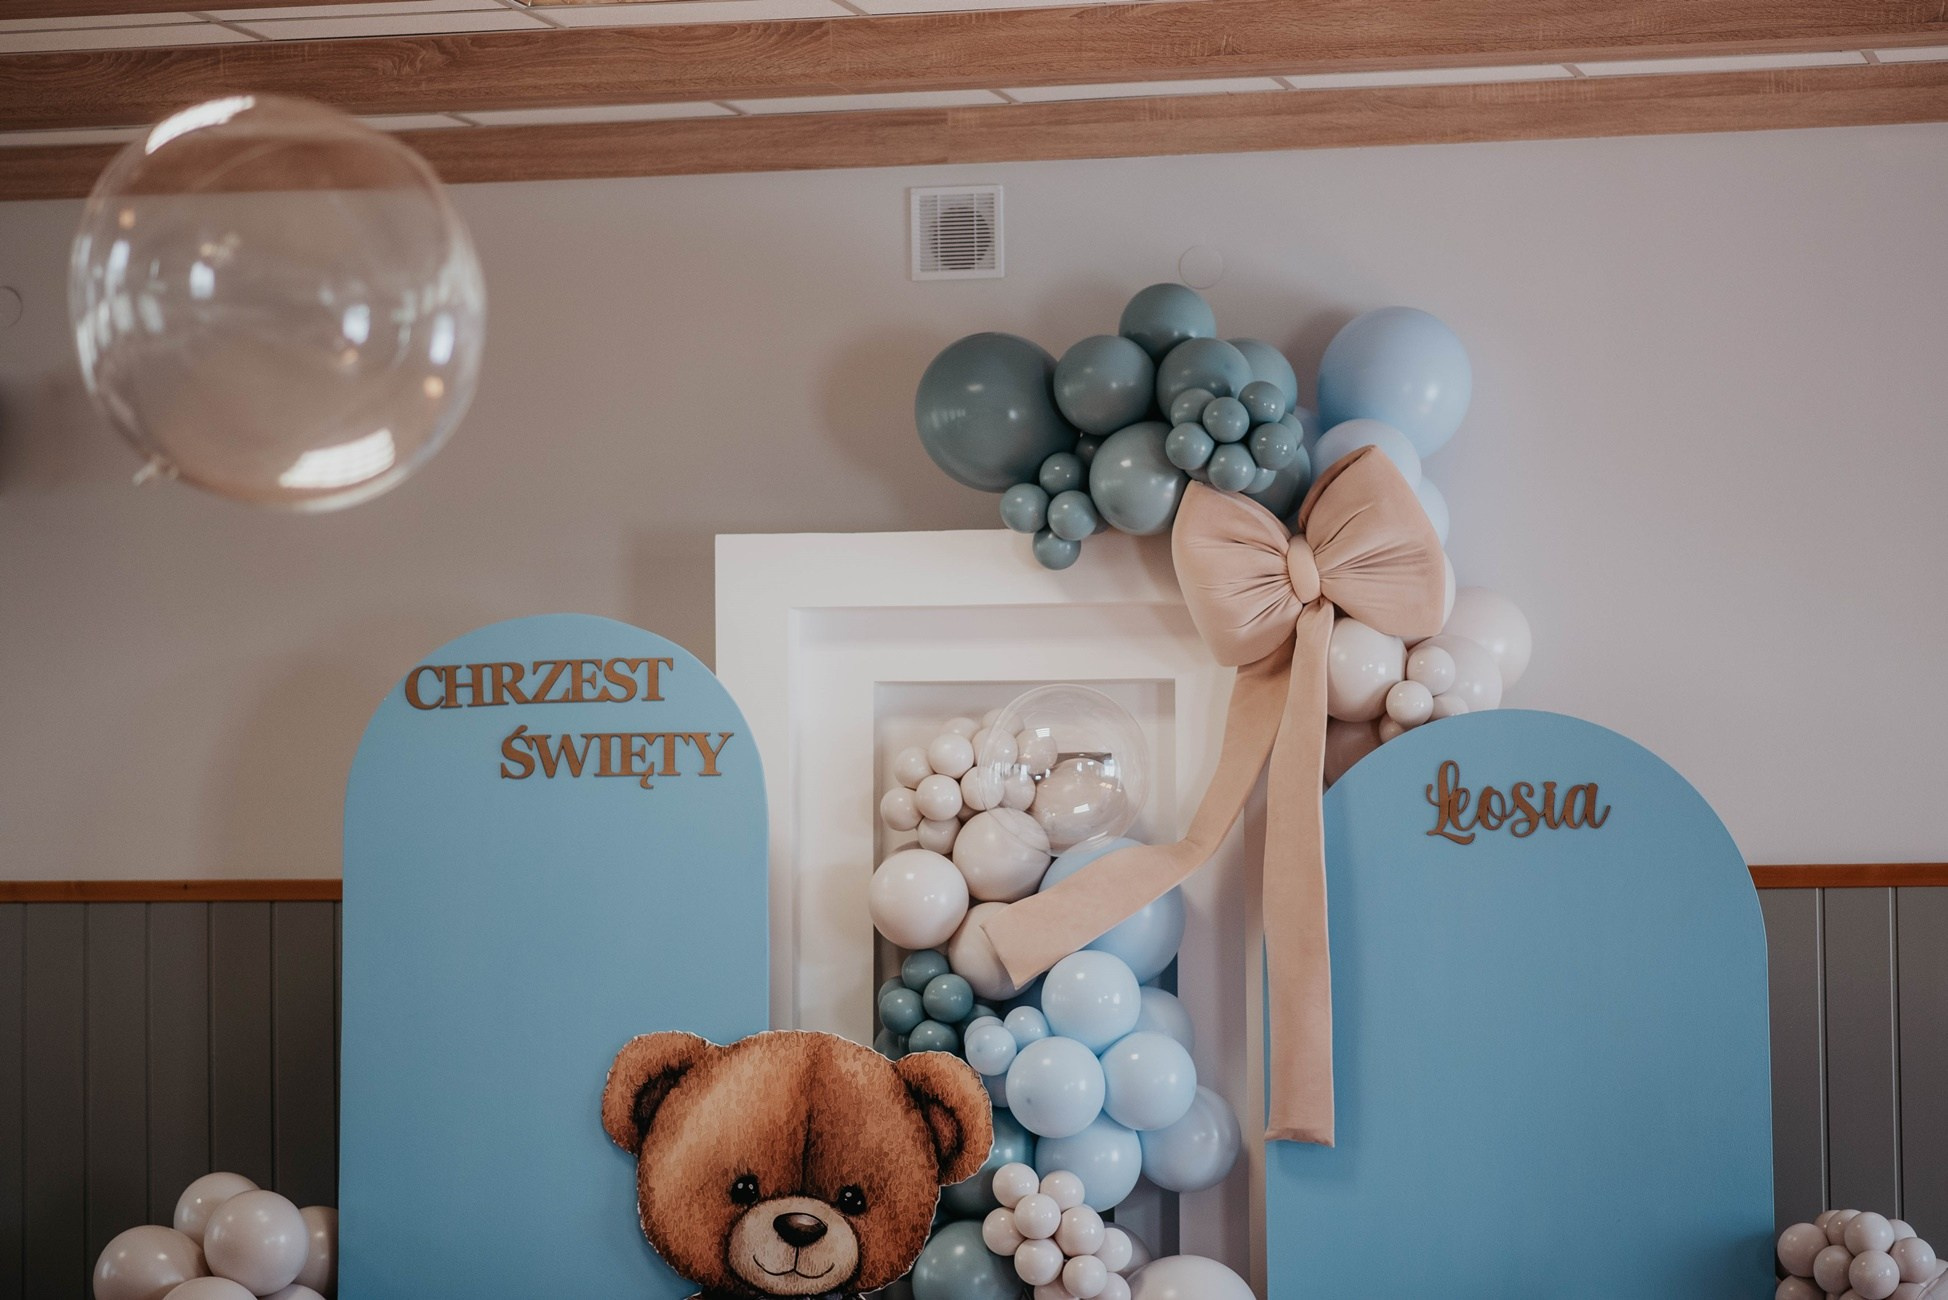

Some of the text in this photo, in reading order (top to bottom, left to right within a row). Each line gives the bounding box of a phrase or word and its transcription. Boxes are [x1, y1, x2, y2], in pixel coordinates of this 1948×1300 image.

[405, 657, 674, 710] CHRZEST
[500, 725, 734, 789] ŚWIĘTY
[1425, 760, 1611, 845] Leosia
